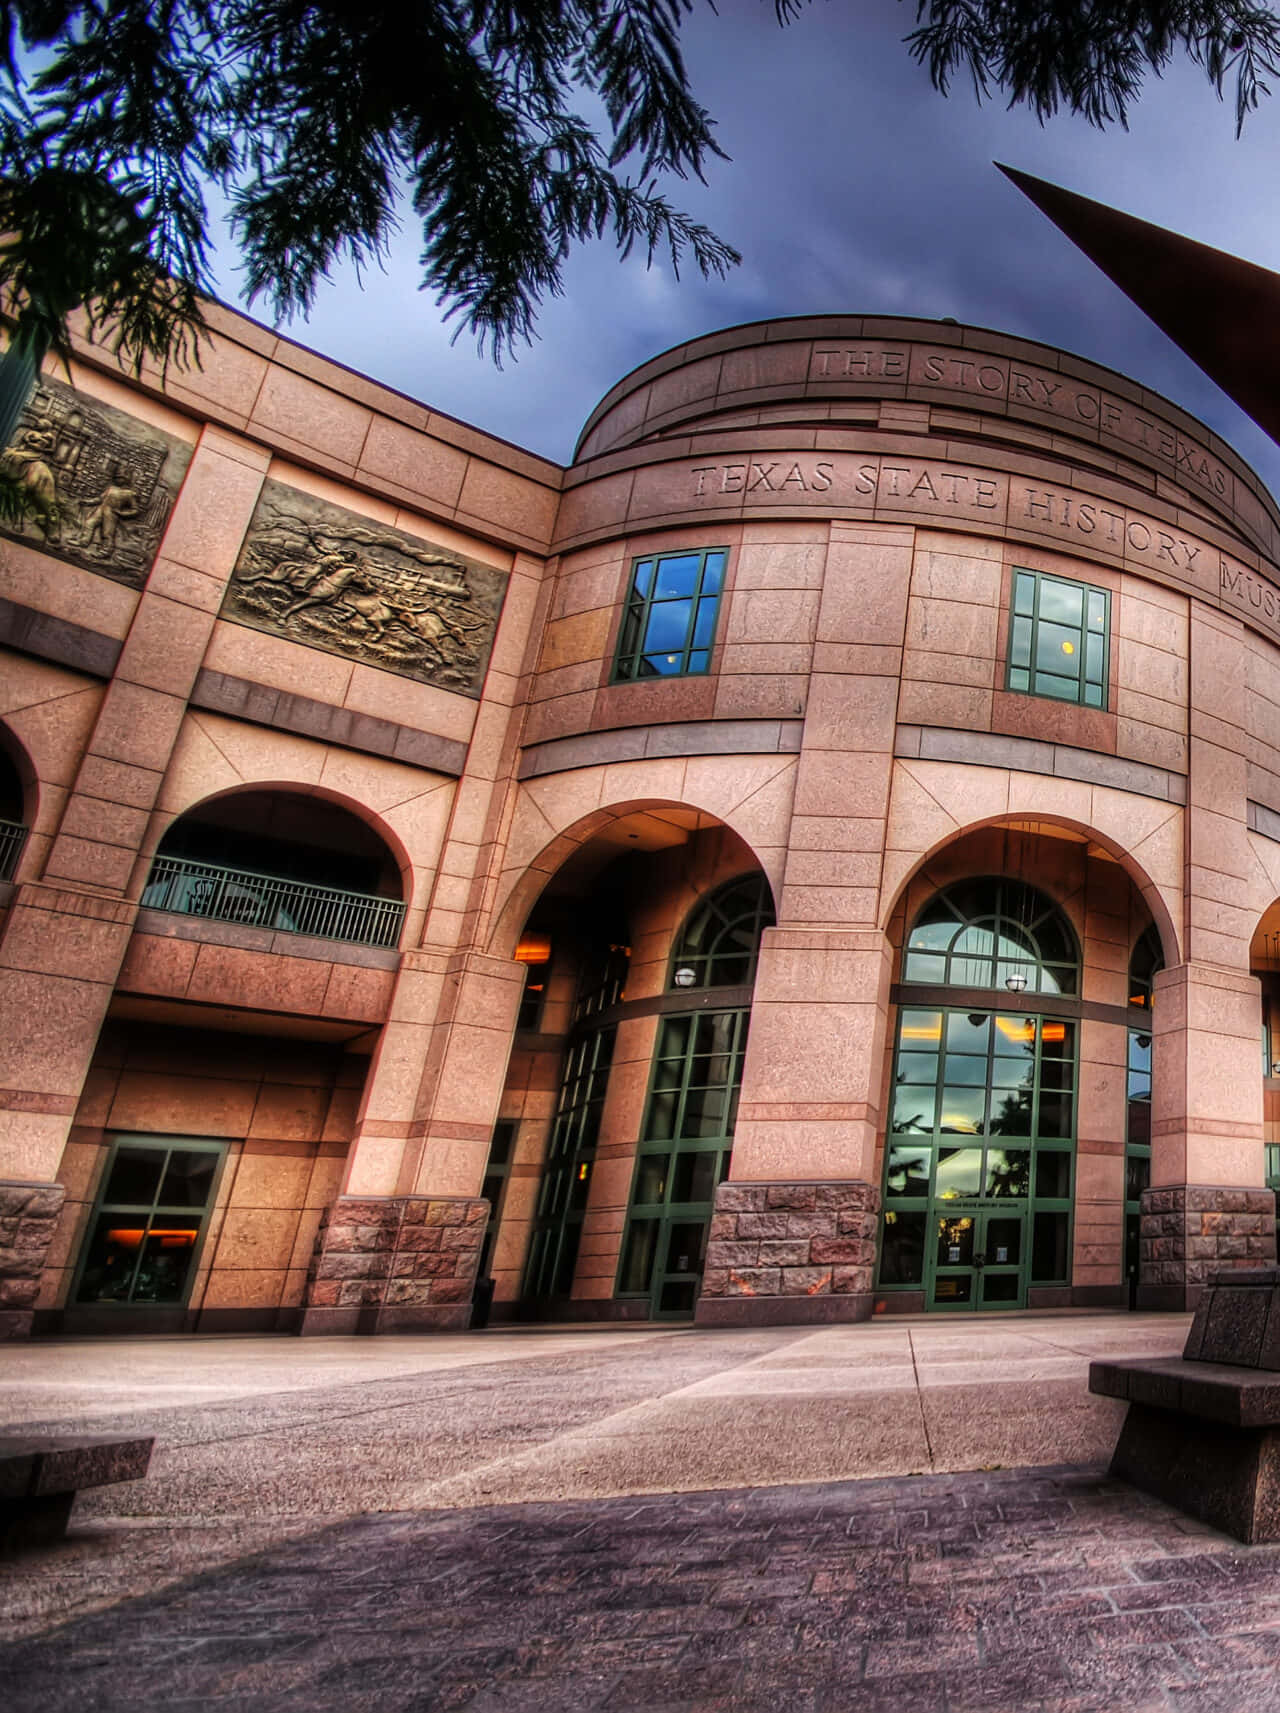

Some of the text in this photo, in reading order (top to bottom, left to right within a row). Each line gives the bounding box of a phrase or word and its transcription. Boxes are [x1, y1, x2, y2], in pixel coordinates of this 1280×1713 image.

[815, 351, 1226, 496] THE STORY OF TEXAS
[691, 462, 834, 496] TEXAS
[854, 464, 998, 509] STATE
[1024, 488, 1202, 572] HISTORY
